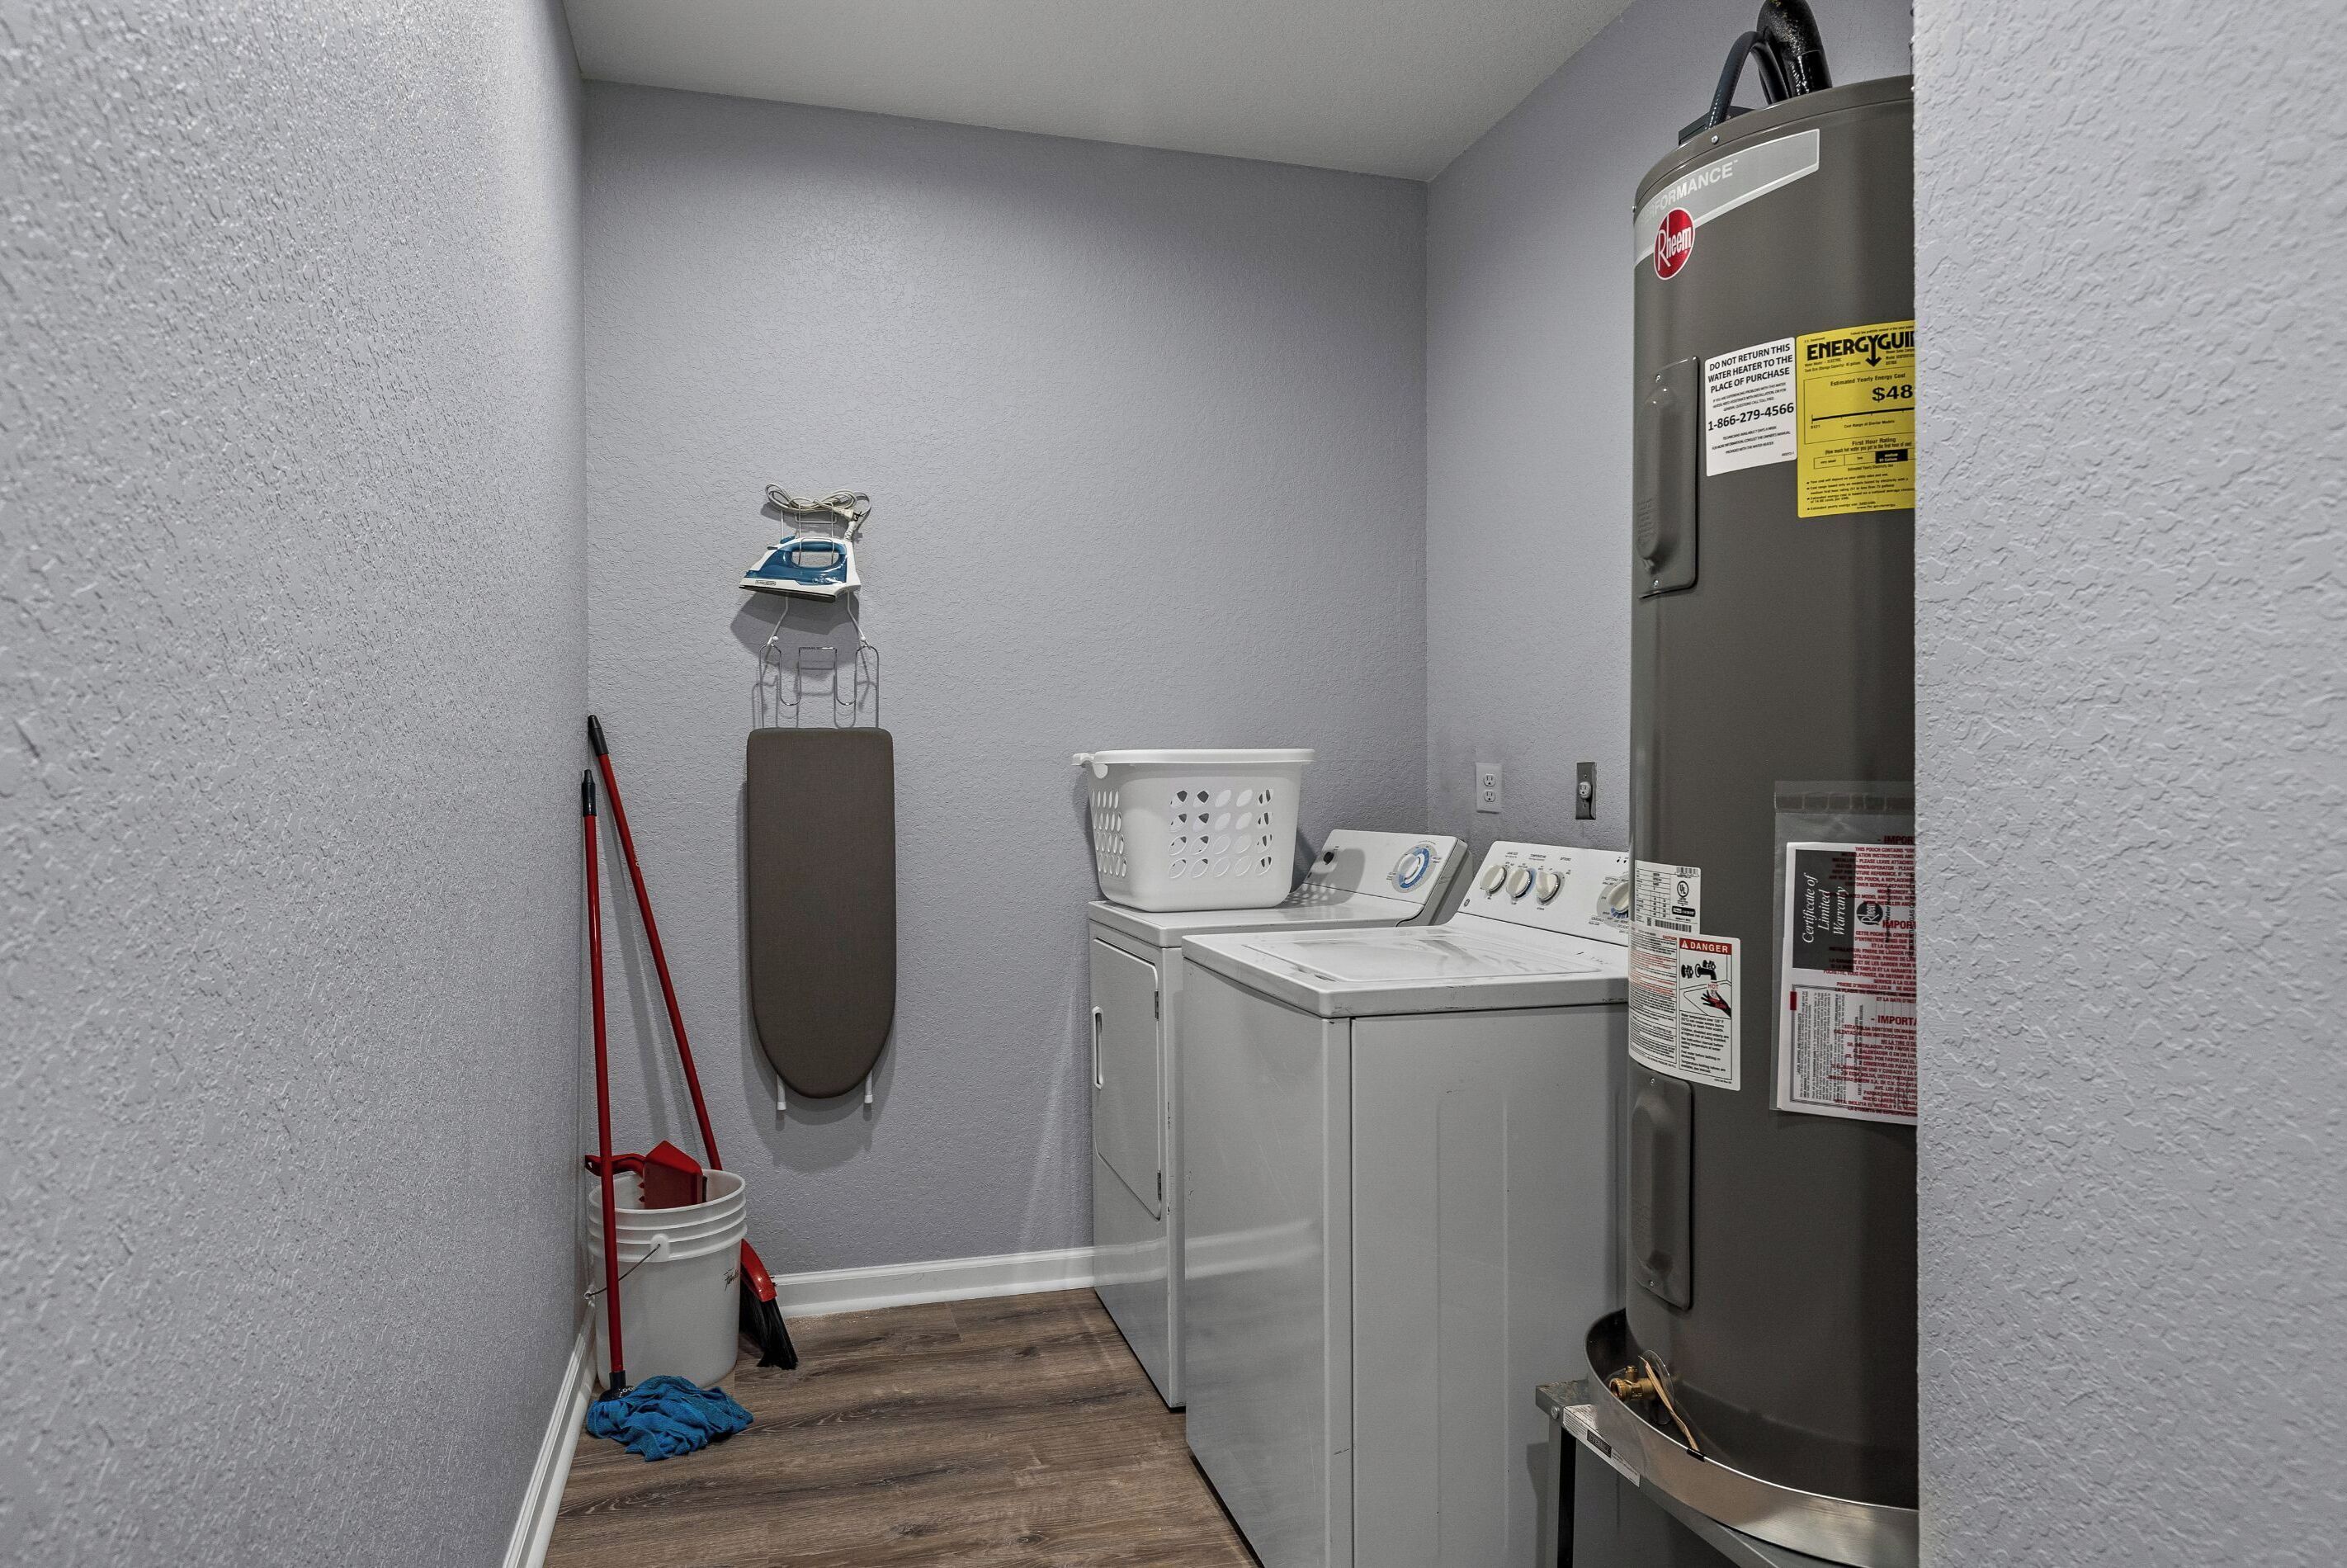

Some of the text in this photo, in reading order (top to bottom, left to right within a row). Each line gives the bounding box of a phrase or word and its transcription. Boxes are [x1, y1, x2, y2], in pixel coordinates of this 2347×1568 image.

[1658, 214, 1691, 271] Rheem
[1708, 355, 1792, 383] WATER HEATER TO THE
[1710, 343, 1790, 371] DO NOT RETURN THIS
[1711, 367, 1790, 393] PLACE OF PURCHASE
[1708, 403, 1794, 431] 1-866-279-4566
[1884, 835, 1914, 844] IMPOR
[1802, 872, 1818, 942] Certificate of
[1818, 889, 1830, 931] Limited
[1834, 886, 1849, 935] Warranty
[1690, 942, 1728, 953] DANGER
